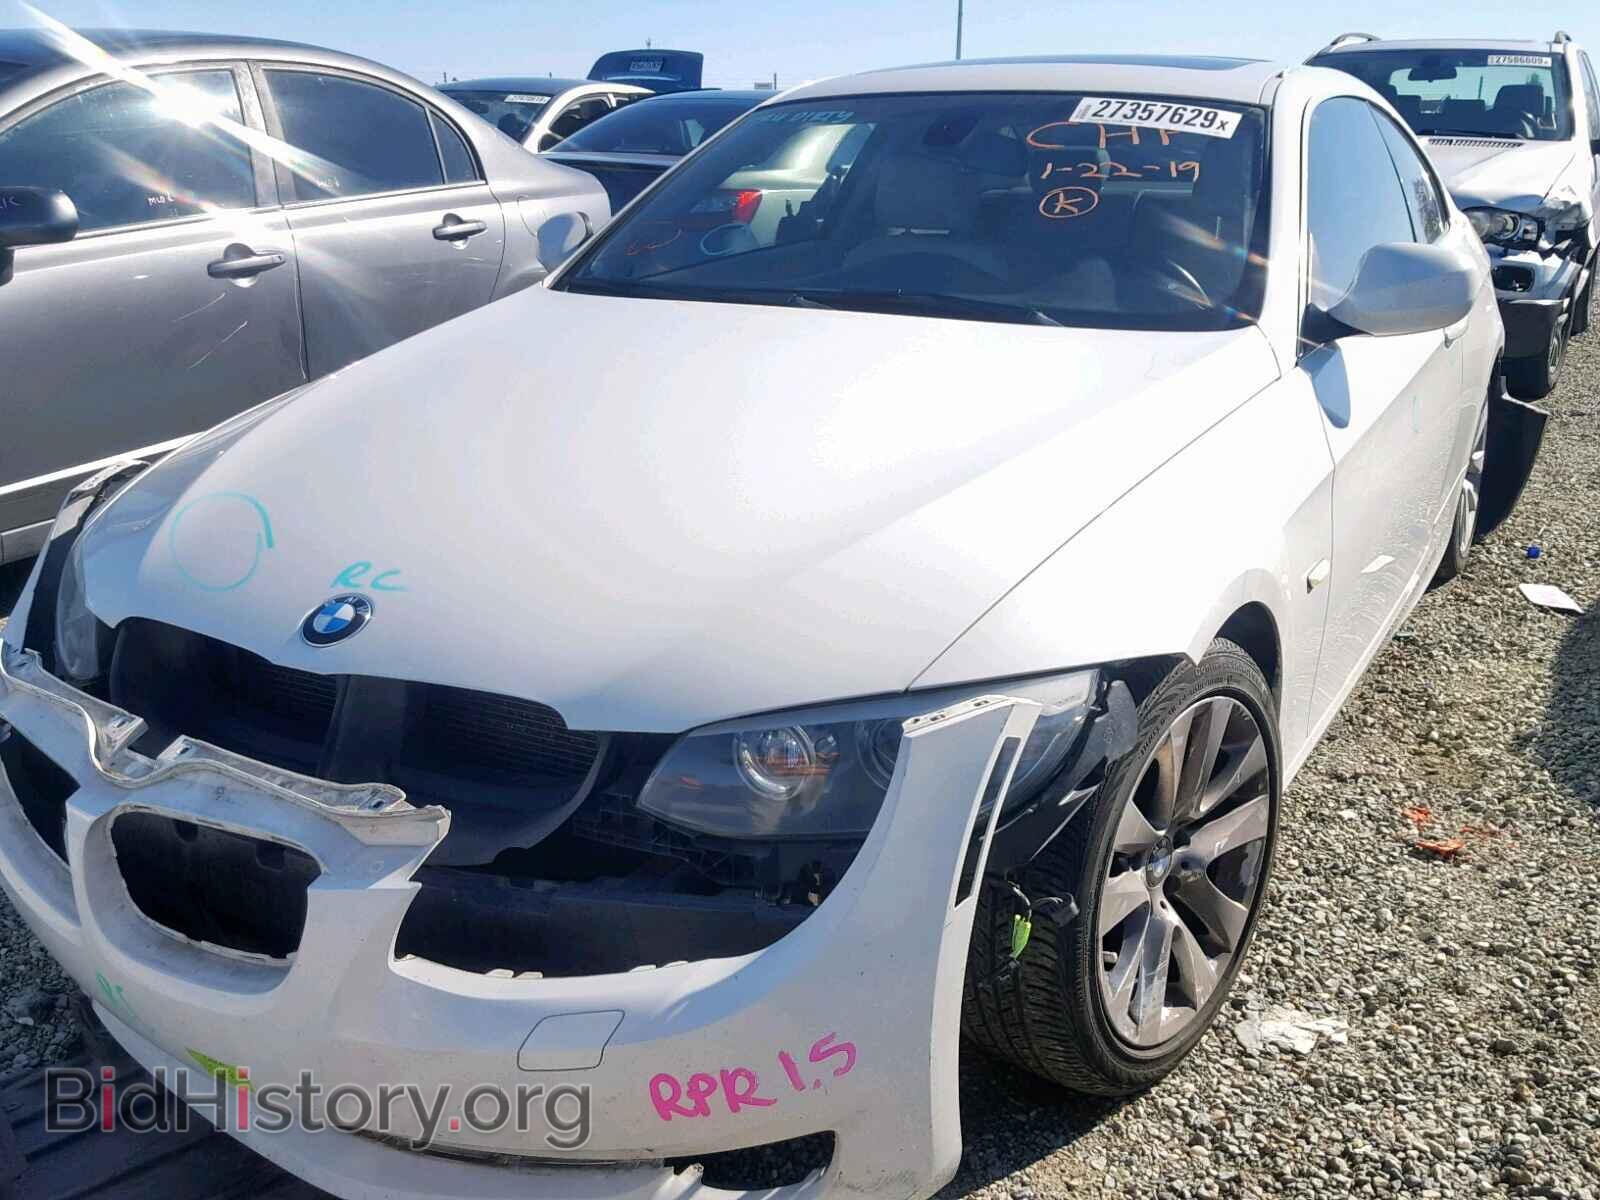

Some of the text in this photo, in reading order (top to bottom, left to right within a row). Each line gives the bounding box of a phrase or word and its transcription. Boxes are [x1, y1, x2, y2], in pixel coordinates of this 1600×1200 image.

[1040, 160, 1200, 182] 1-22-19
[329, 560, 410, 592] RC
[649, 1067, 778, 1121] RPR
